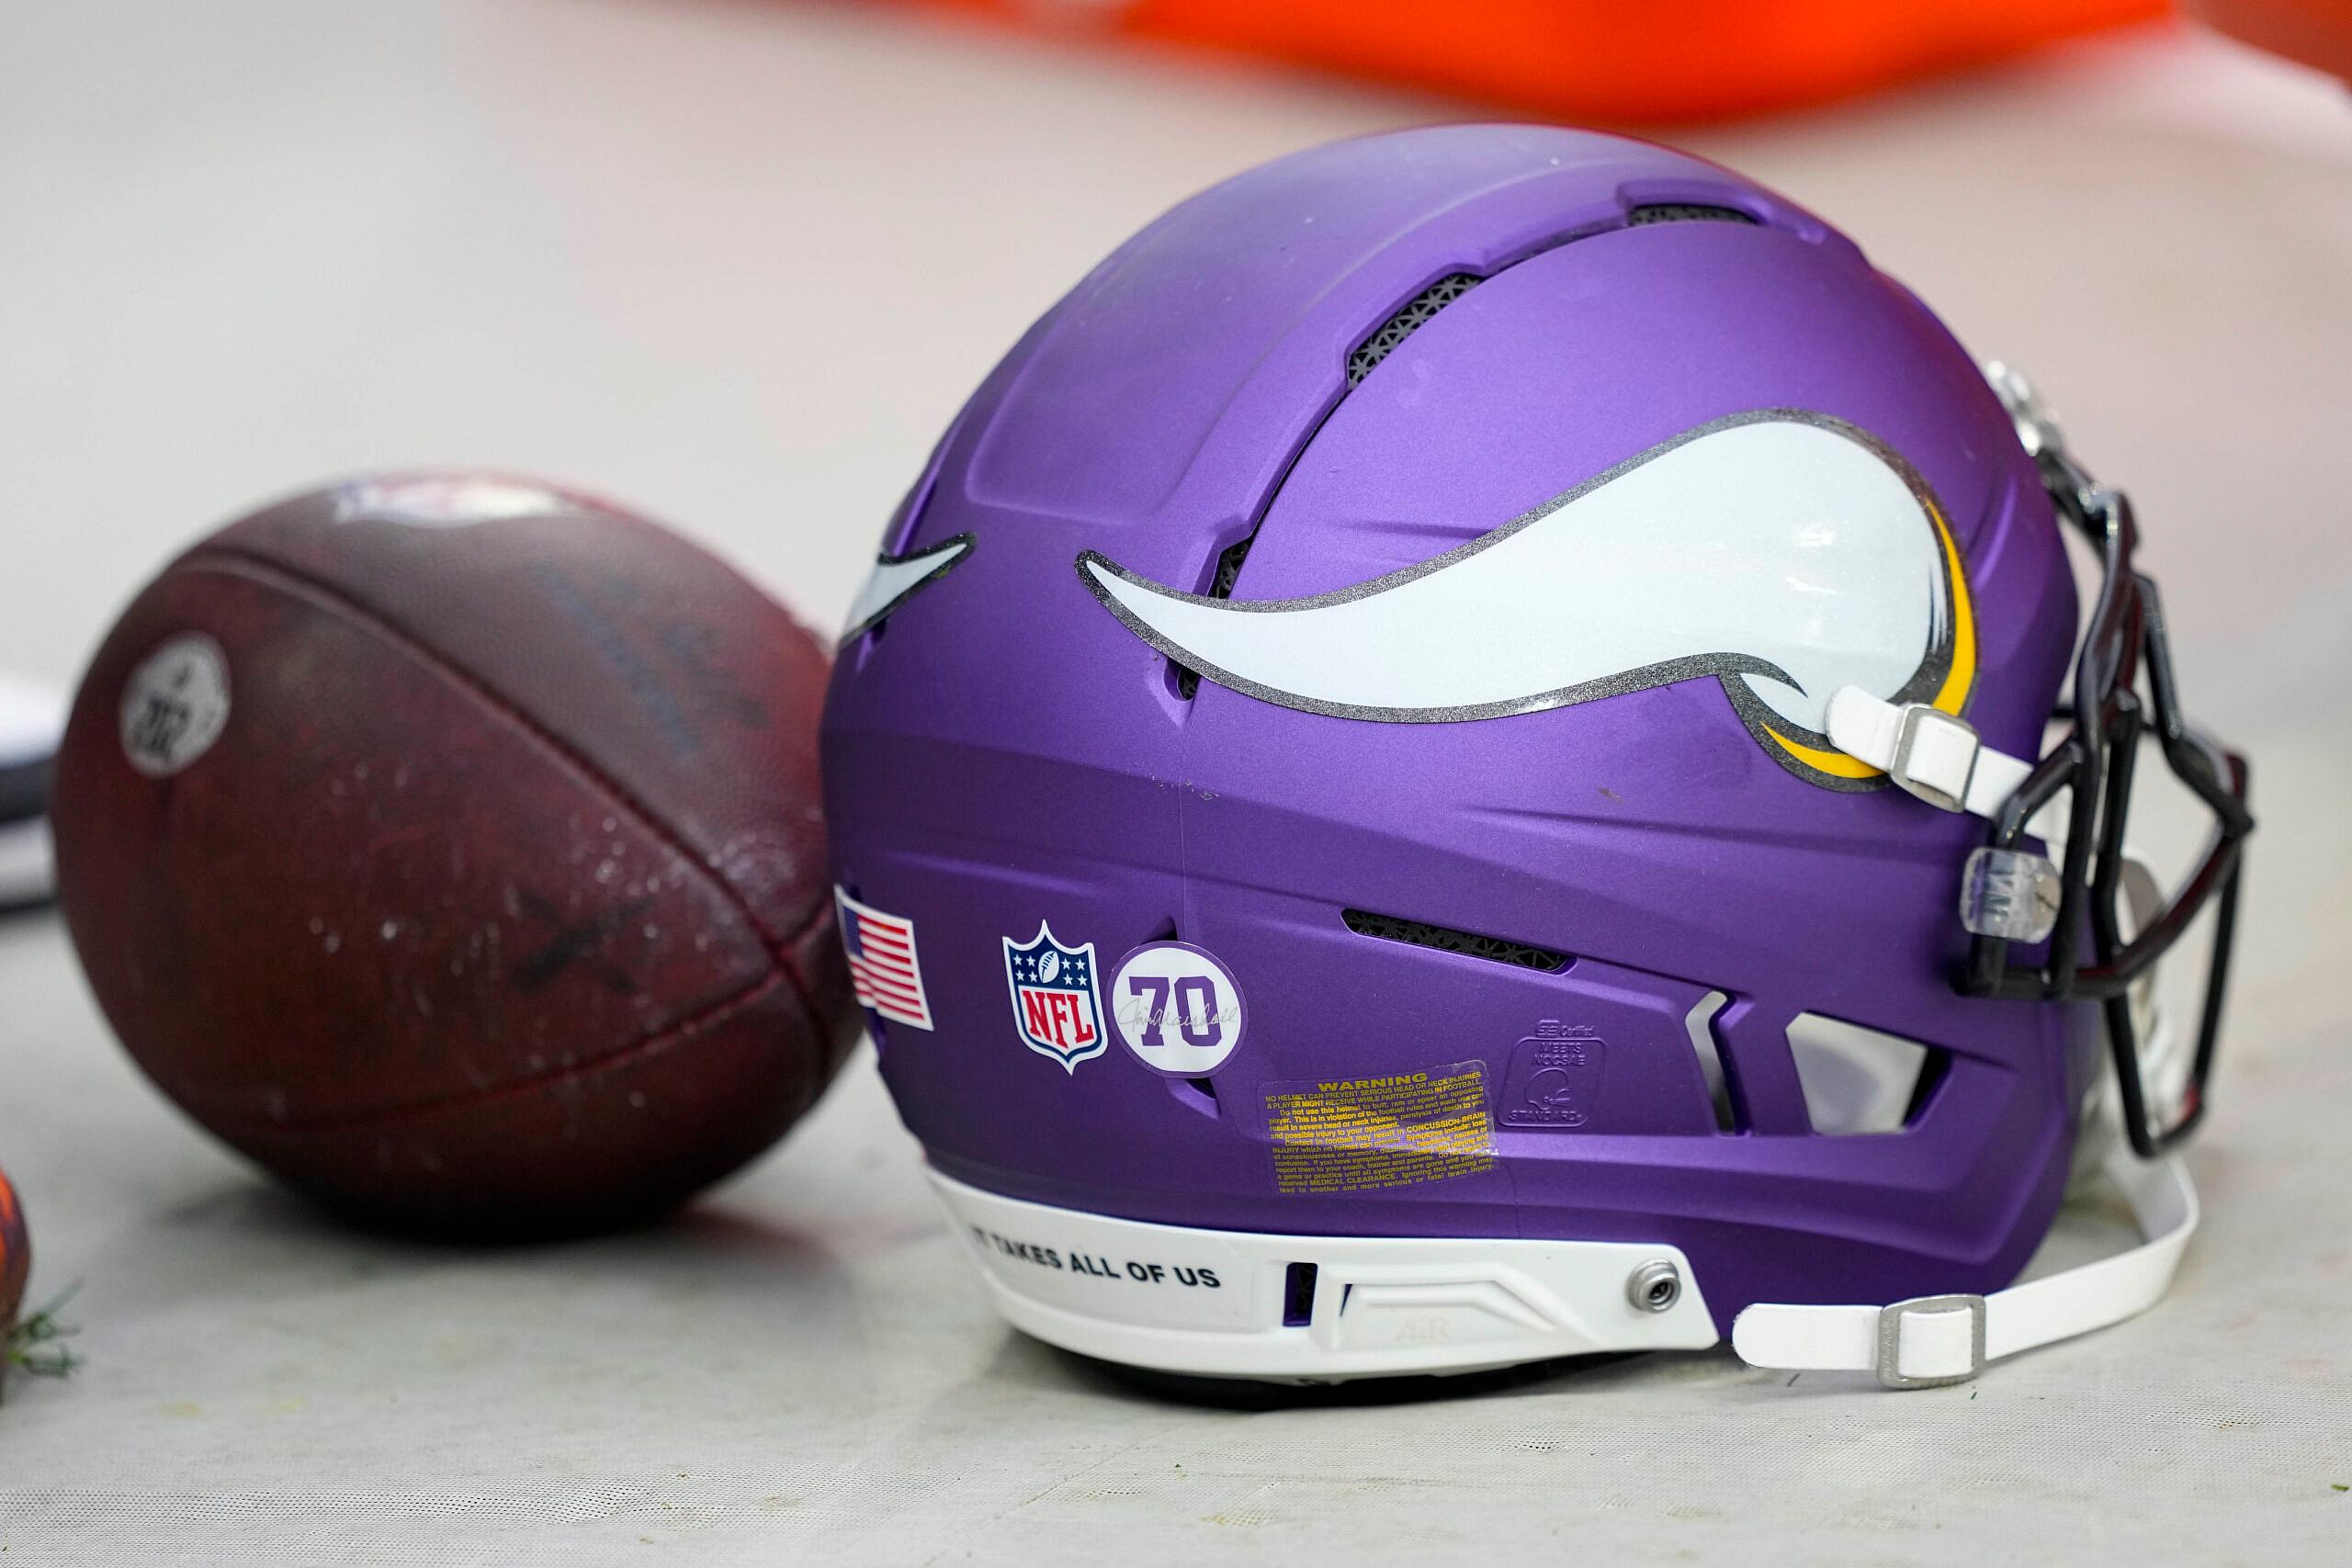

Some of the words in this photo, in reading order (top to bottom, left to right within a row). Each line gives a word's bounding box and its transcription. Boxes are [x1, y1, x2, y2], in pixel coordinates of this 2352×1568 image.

[1022, 990, 1094, 1049] NFL
[1128, 976, 1223, 1047] 70
[1540, 1042, 1581, 1054] MEETS
[1317, 1073, 1428, 1092] WARNING
[1325, 1089, 1358, 1098] PREVENT
[1360, 1086, 1392, 1095] SERIOUS
[1394, 1083, 1413, 1092] HEAD
[1428, 1077, 1448, 1087] NECK
[1325, 1097, 1356, 1105] RECEIVE
[1381, 1088, 1433, 1100] PARTICIPATING
[1326, 1111, 1356, 1120] violation
[1336, 1104, 1361, 1112] helmet
[1325, 1135, 1352, 1144] football
[1373, 1130, 1394, 1138] result
[1406, 1111, 1486, 1133] CONCUSSION-BRAIN
[1472, 1119, 1486, 1127] loss
[1284, 1131, 1315, 1139] possible
[991, 1234, 1063, 1269] TAKES
[1069, 1252, 1122, 1279] ALL
[1126, 1260, 1166, 1283] OF
[1174, 1267, 1221, 1288] US
